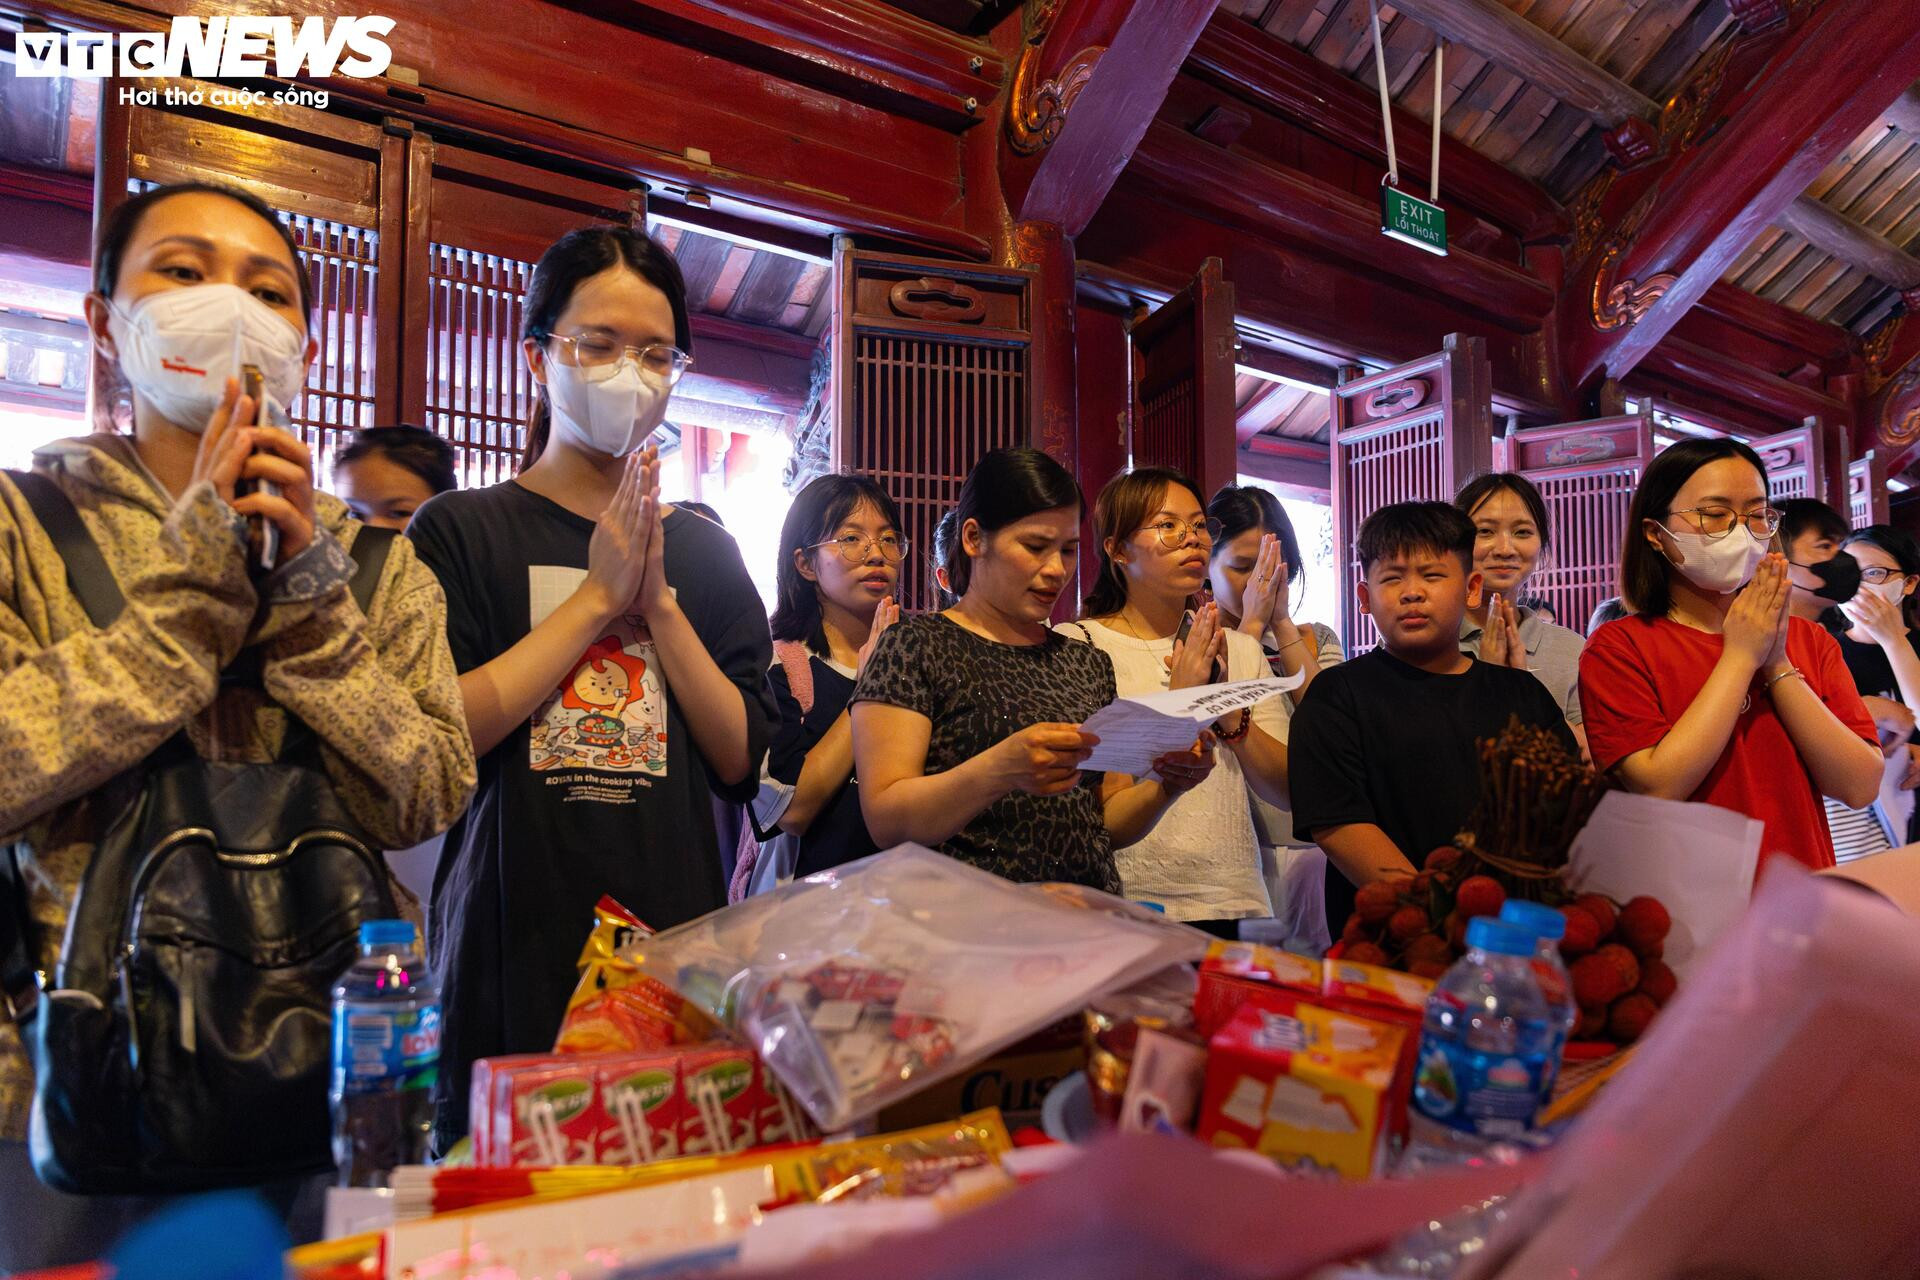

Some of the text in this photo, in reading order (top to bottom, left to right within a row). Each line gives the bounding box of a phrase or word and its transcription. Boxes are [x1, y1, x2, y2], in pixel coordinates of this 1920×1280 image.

[1400, 200, 1432, 224] EXIT
[1395, 215, 1440, 242] LỐI THOÁT
[574, 773, 583, 782] in
[585, 773, 599, 783] the
[600, 776, 633, 787] cooking
